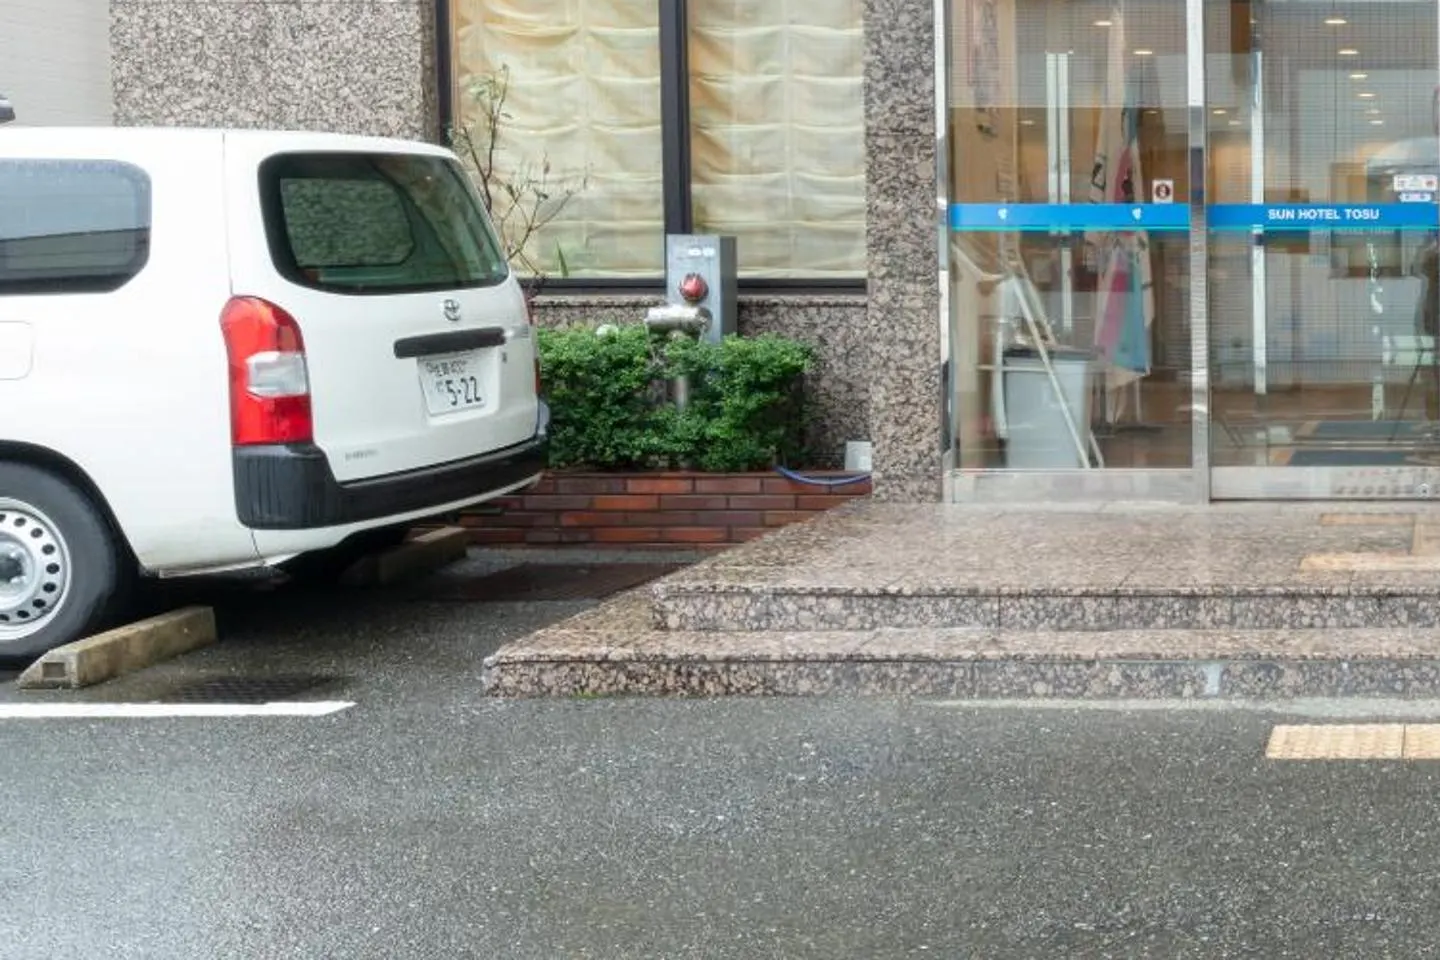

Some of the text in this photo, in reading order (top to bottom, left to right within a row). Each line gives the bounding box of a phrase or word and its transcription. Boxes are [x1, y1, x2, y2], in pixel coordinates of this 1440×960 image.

[1267, 208, 1380, 221] SUN HOTEL TOSU
